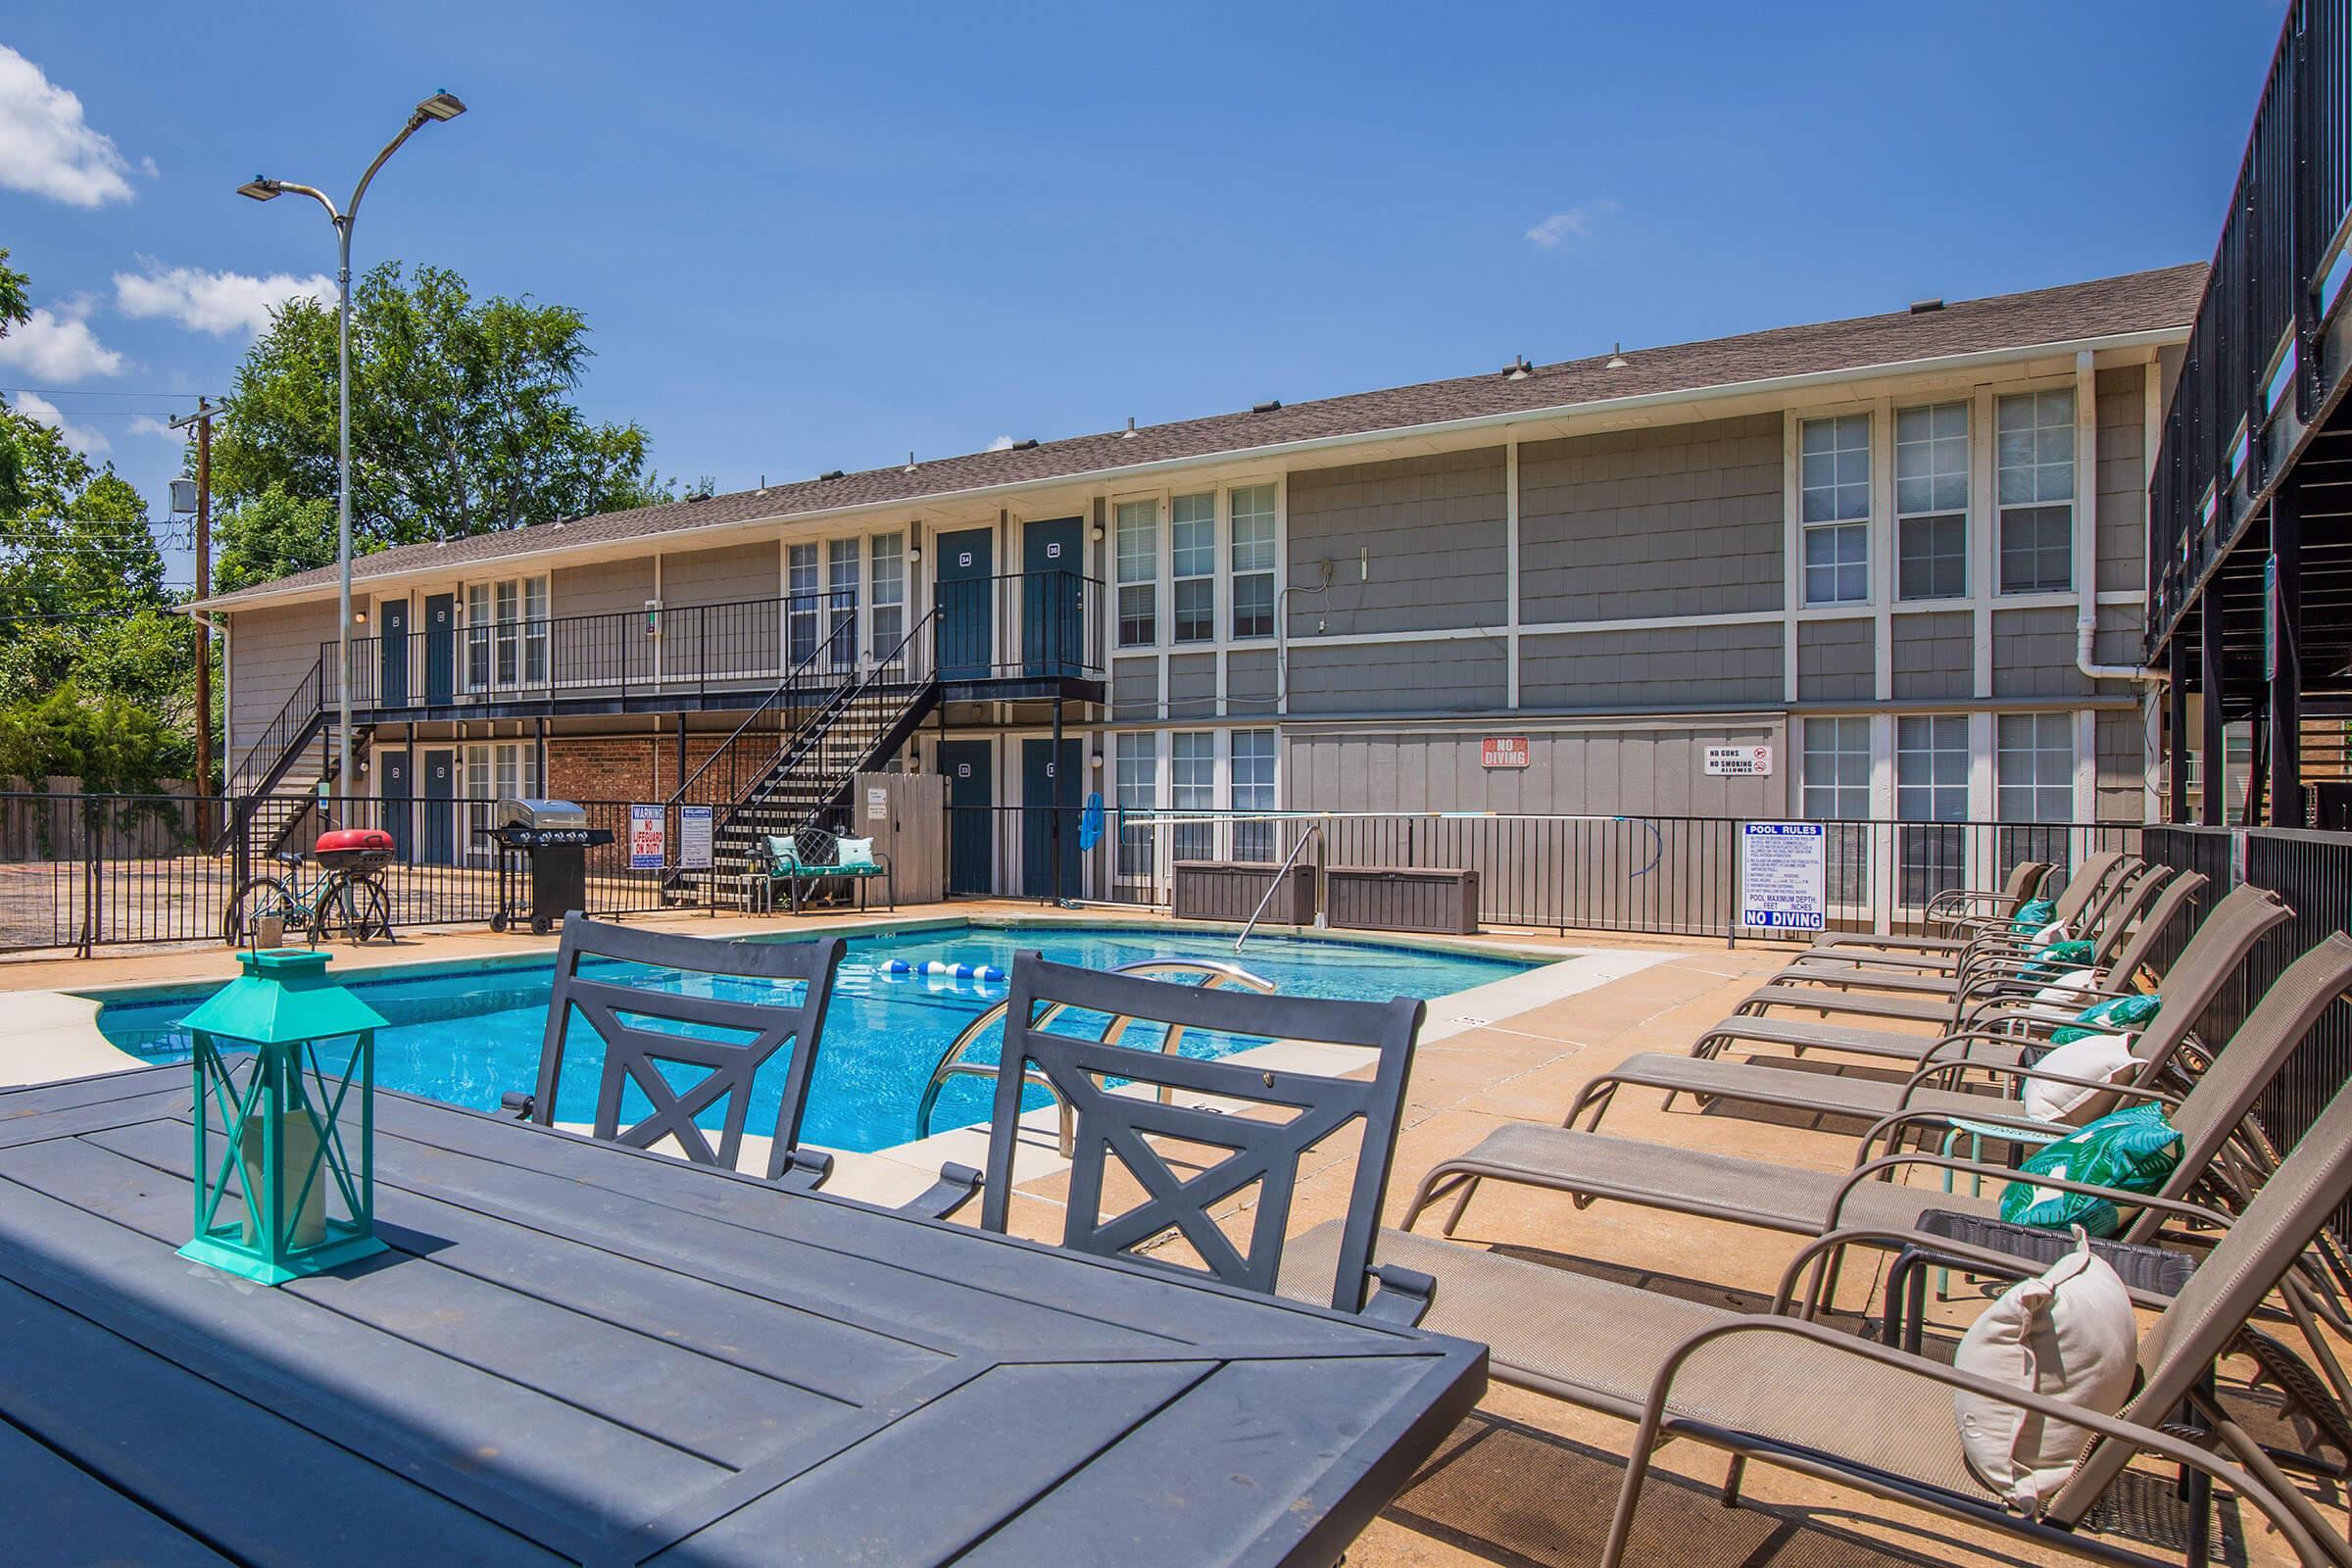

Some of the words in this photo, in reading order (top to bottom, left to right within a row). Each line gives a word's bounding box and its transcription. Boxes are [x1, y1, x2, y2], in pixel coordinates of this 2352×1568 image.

[1497, 739, 1513, 751] NO
[1486, 752, 1525, 763] DIVING
[634, 807, 663, 818] WARNING
[645, 820, 653, 831] NO
[1750, 825, 1778, 834] POOL
[1783, 825, 1817, 834] RULES
[633, 831, 663, 843] LIFEGUARD
[636, 843, 644, 854] ON
[647, 843, 660, 854] DUTY
[1746, 910, 1766, 924] NO
[1772, 912, 1820, 927] DIVING
